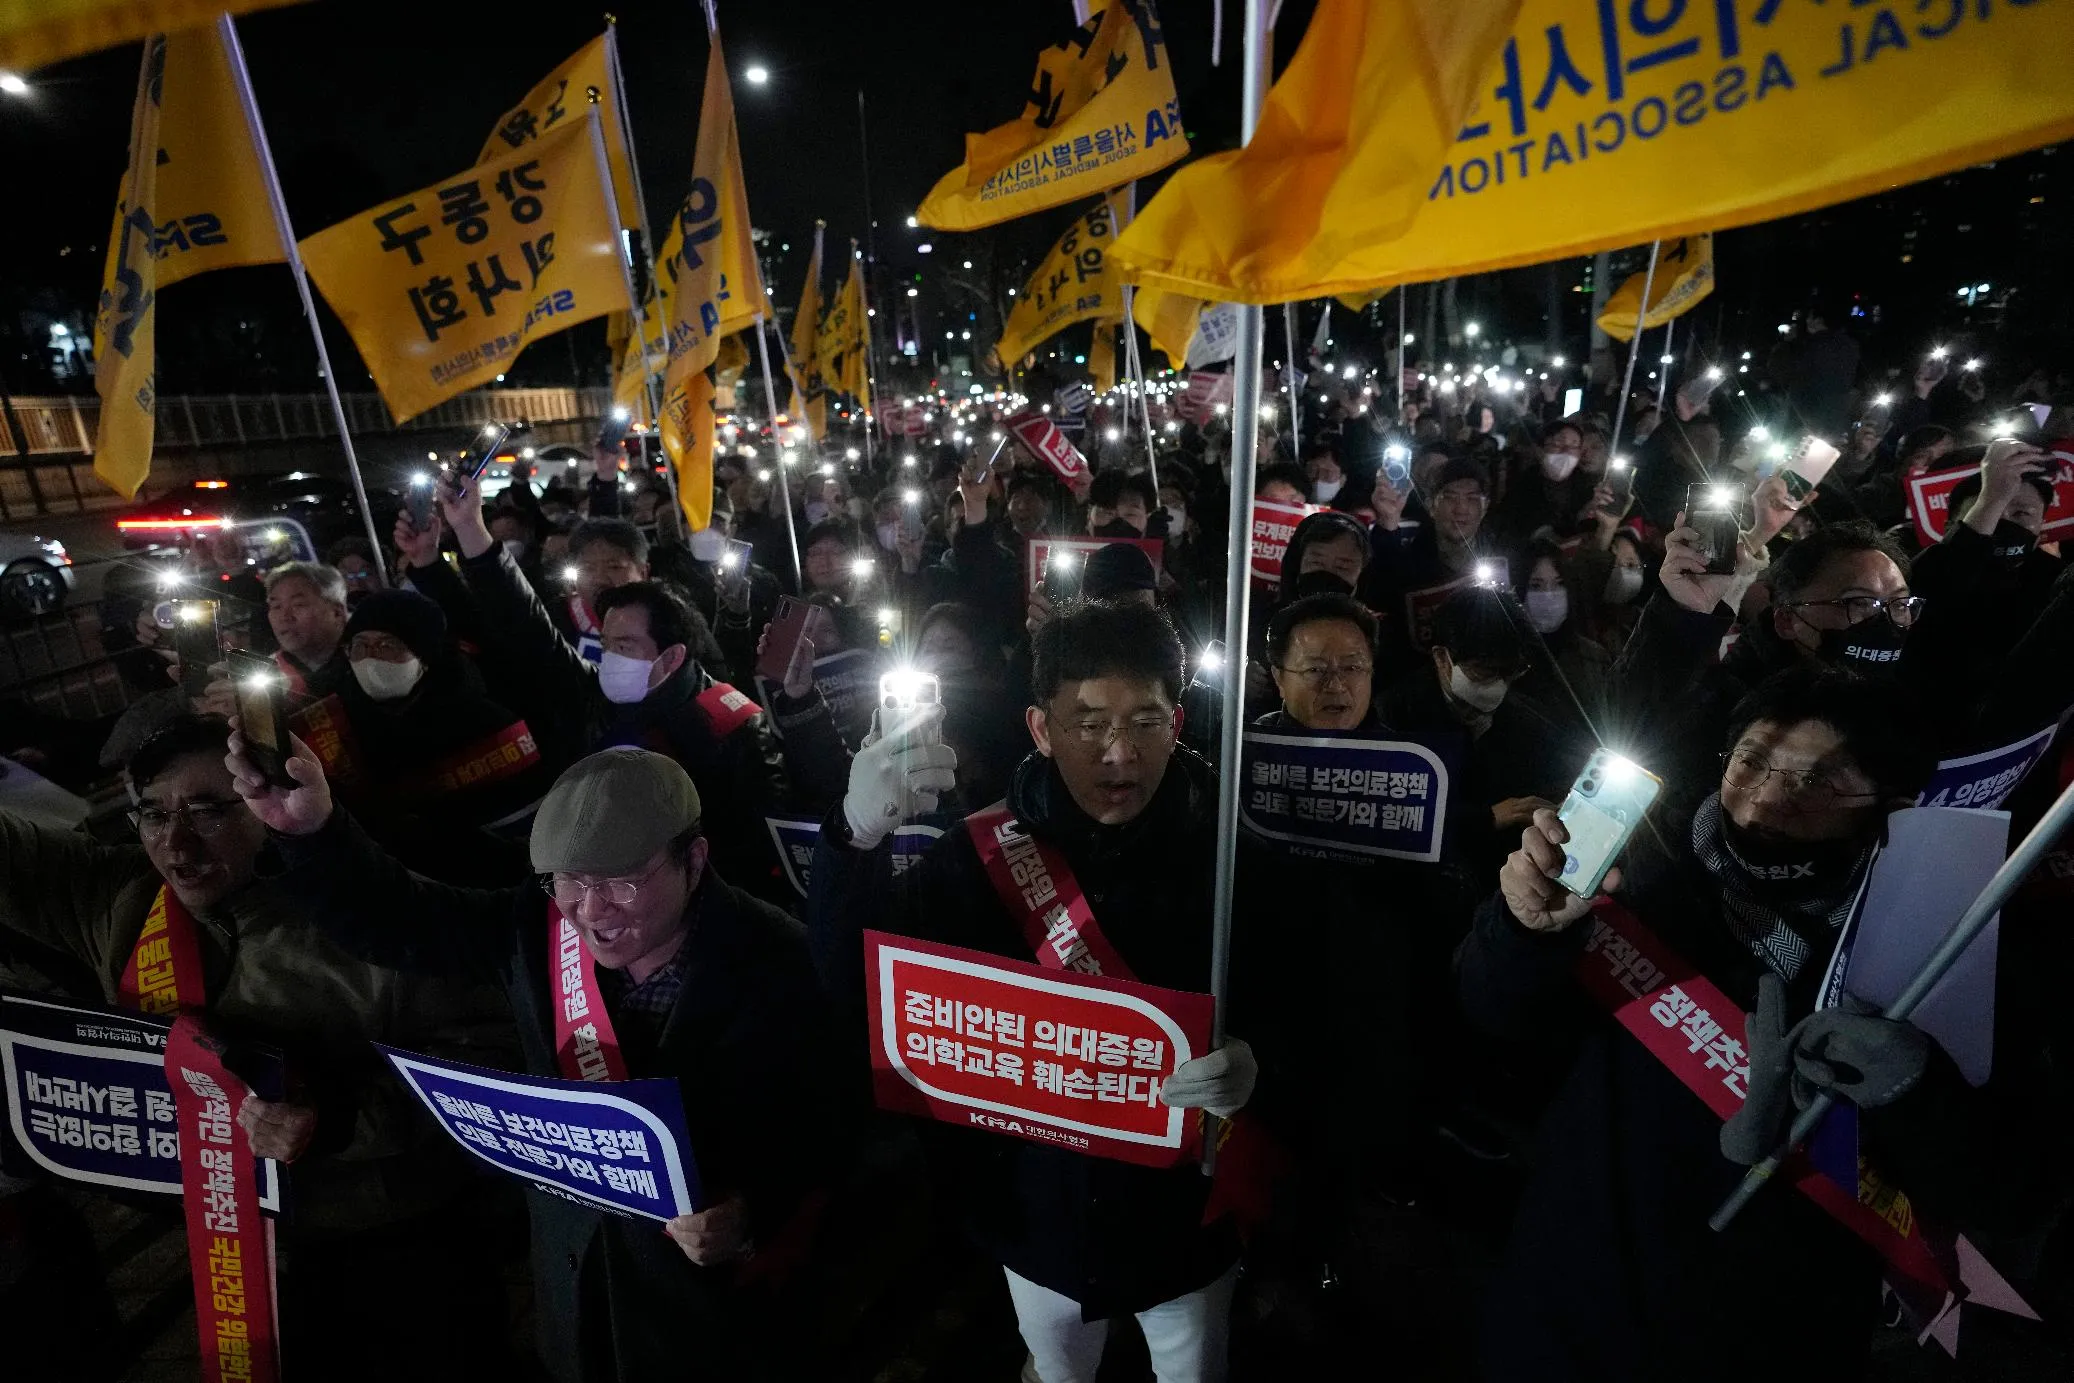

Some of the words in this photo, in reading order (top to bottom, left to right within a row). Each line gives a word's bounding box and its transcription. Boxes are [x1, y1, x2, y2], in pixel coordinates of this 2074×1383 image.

[1251, 760, 1308, 791] 올바른
[1311, 767, 1429, 800] 보건의료정책
[1251, 790, 1291, 817] 의료
[1295, 795, 1381, 828] 전문가와
[1381, 802, 1425, 832] 함께
[904, 989, 1026, 1049] 준비안된
[1032, 1020, 1165, 1071] 의대증원
[25, 1069, 138, 1118] 결사반대
[906, 1031, 1025, 1087] 의학교육
[1031, 1059, 1162, 1109] 훼손된다
[31, 1108, 141, 1156] 합의없는
[499, 1110, 651, 1163] 보건의료정책
[200, 1148, 239, 1233] 정책추진
[499, 1136, 603, 1185] 전문가와
[602, 1163, 660, 1200] 함께
[209, 1237, 246, 1315] 국민건강
